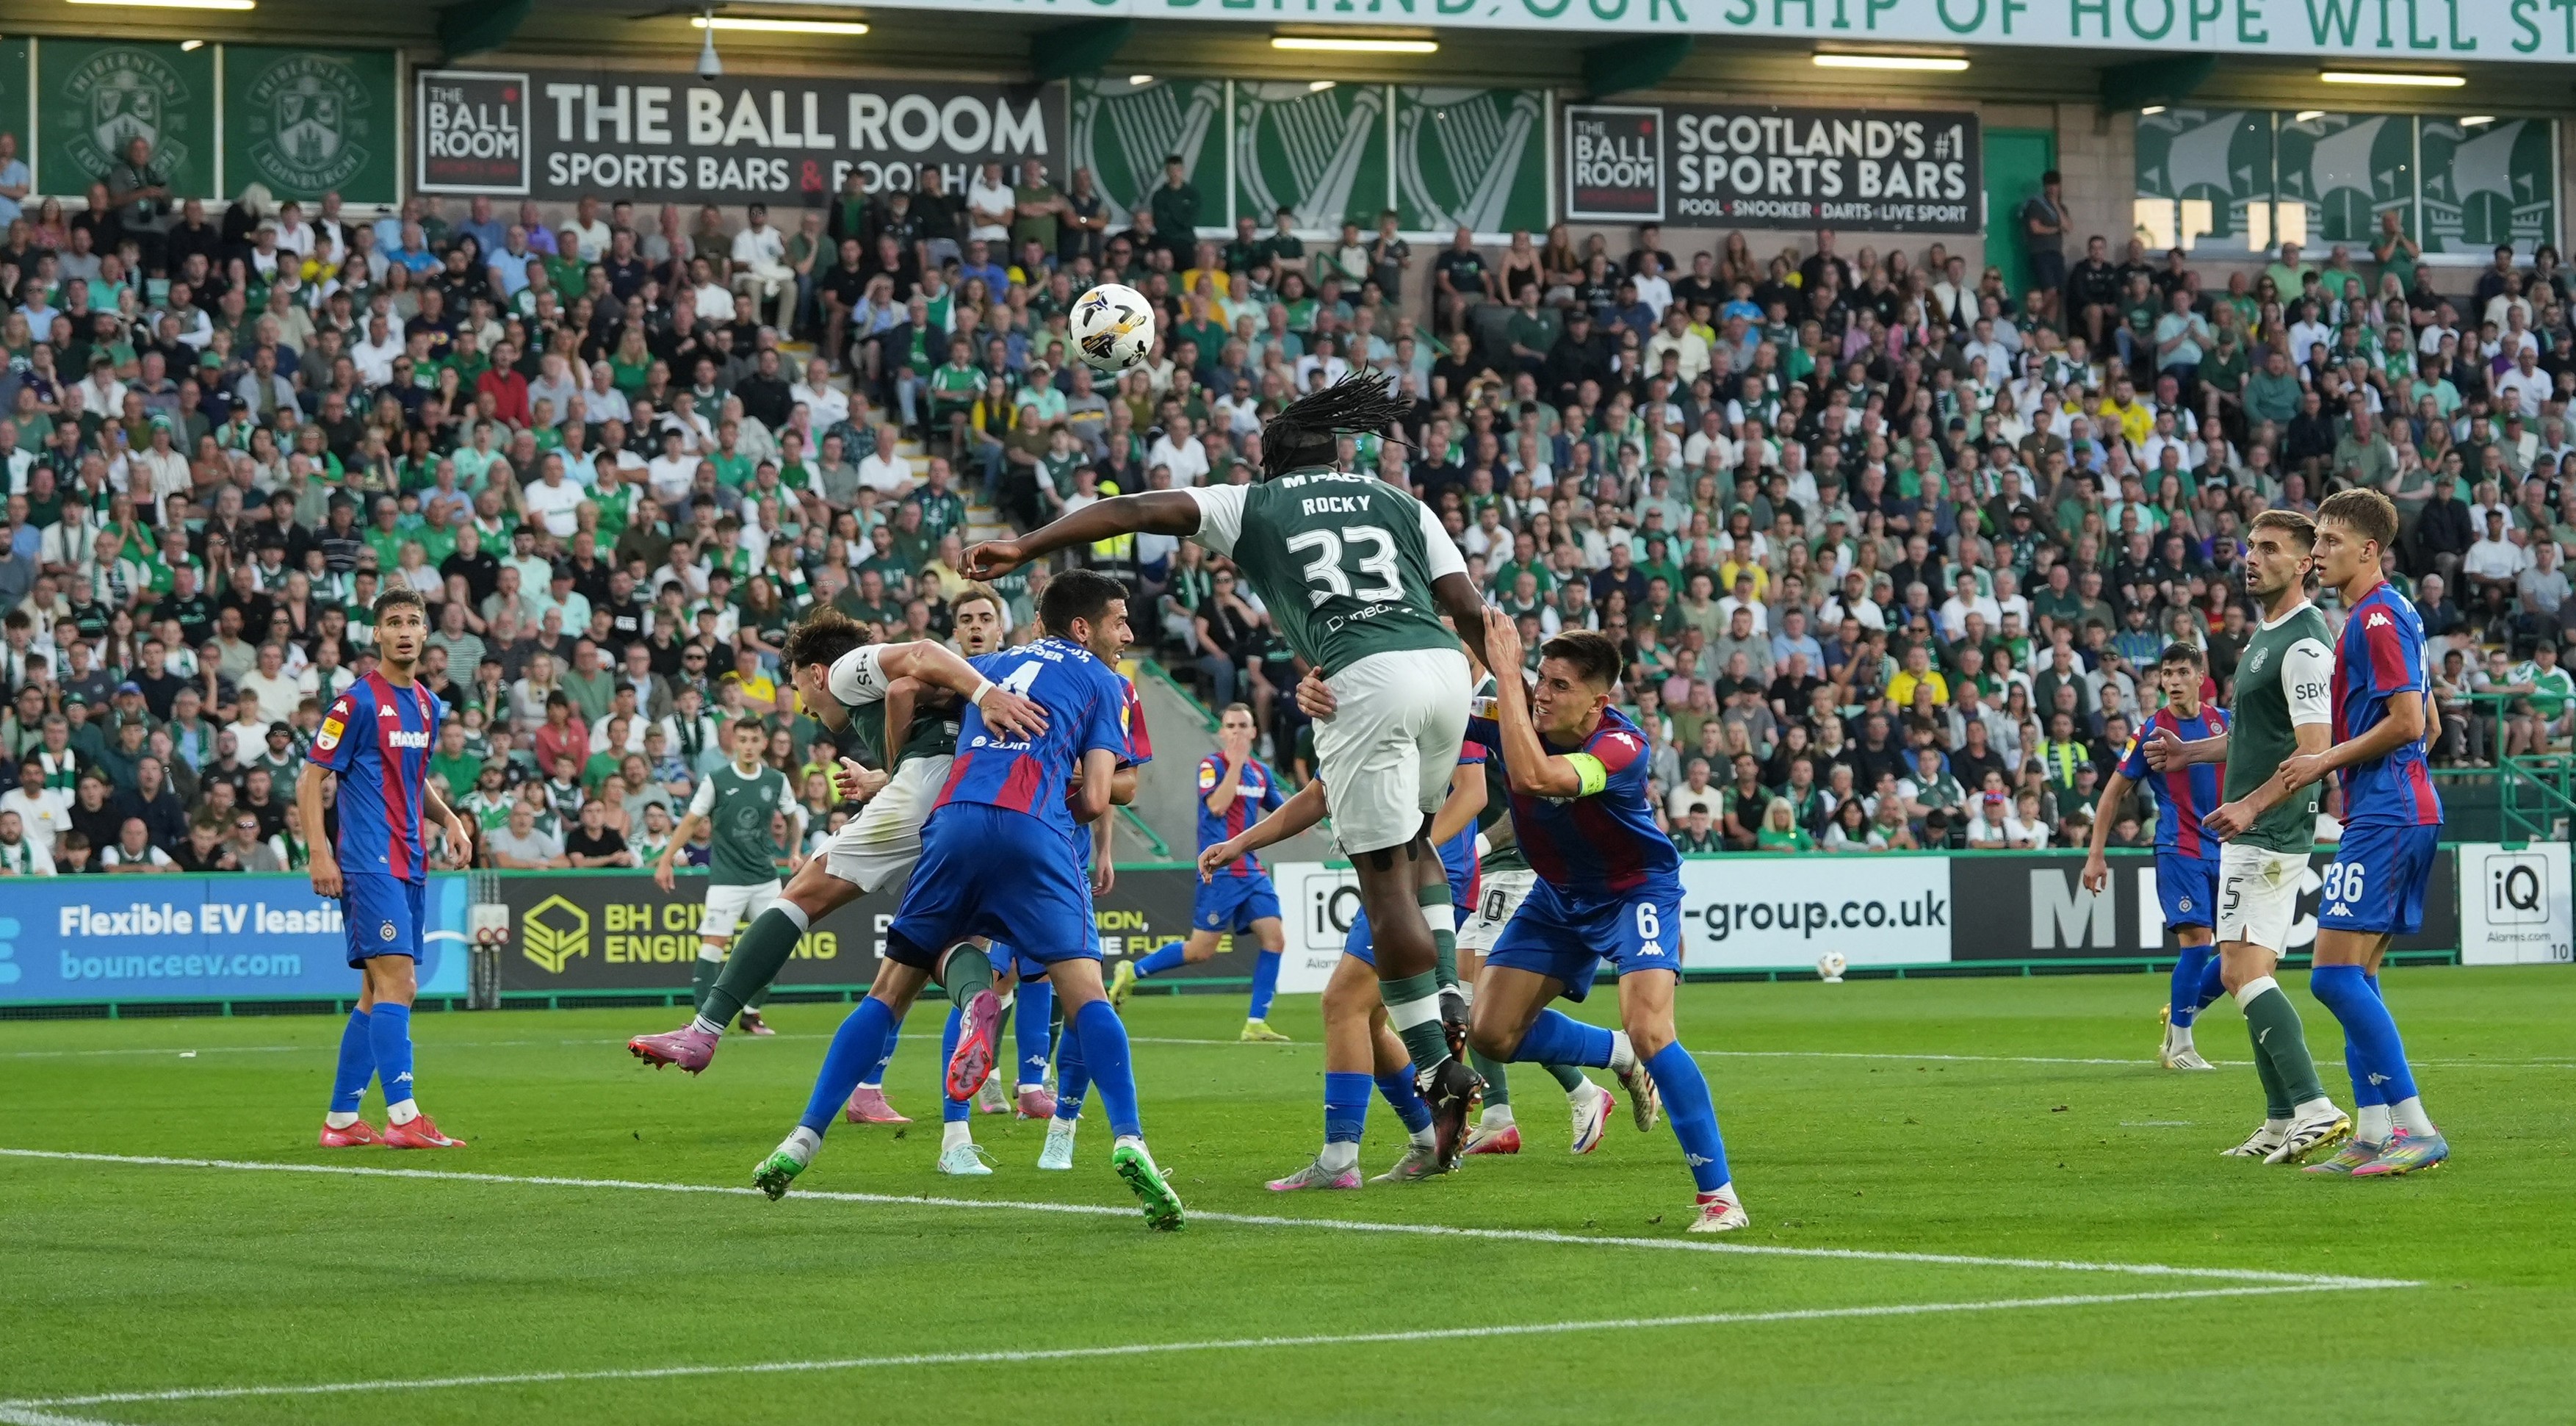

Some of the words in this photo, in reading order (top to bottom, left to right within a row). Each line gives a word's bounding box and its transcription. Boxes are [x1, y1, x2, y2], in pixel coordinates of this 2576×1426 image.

[2071, 0, 2268, 43] HOPE
[2304, 0, 2477, 50] WILL
[429, 86, 464, 104] THE
[429, 101, 519, 132] BALL
[546, 83, 672, 144] THE
[687, 87, 837, 149] BALL
[848, 93, 1048, 155] ROOM
[1576, 120, 1606, 136] THE
[429, 129, 519, 159] ROOM
[1576, 134, 1654, 163] BALL
[1676, 114, 1925, 160] SCOTLAND'S
[1934, 123, 1963, 161] #1
[548, 151, 688, 190] SPORTS
[696, 156, 790, 192] BARS
[801, 159, 823, 192] &
[1576, 161, 1655, 187] ROOM
[1676, 155, 1843, 197] SPORTS
[1858, 159, 1966, 201] BARS
[1678, 198, 1723, 215] POOL
[1733, 200, 1812, 218] SNOOKER
[1821, 203, 1872, 220] DARTS
[1881, 204, 1915, 221] LIVE
[1919, 204, 1967, 223] SPORT
[1302, 495, 1371, 516] ROCKY
[1286, 525, 1406, 608] 33
[2223, 877, 2243, 909] 5
[2326, 863, 2364, 902] 36
[2495, 865, 2539, 912] iQ
[60, 902, 192, 936] Flexible
[200, 904, 248, 934] EV
[255, 901, 345, 934] leasin
[605, 904, 652, 931] BH
[1637, 902, 1659, 939] 6
[62, 949, 302, 980] bounceev.com
[2550, 943, 2569, 960] 10
